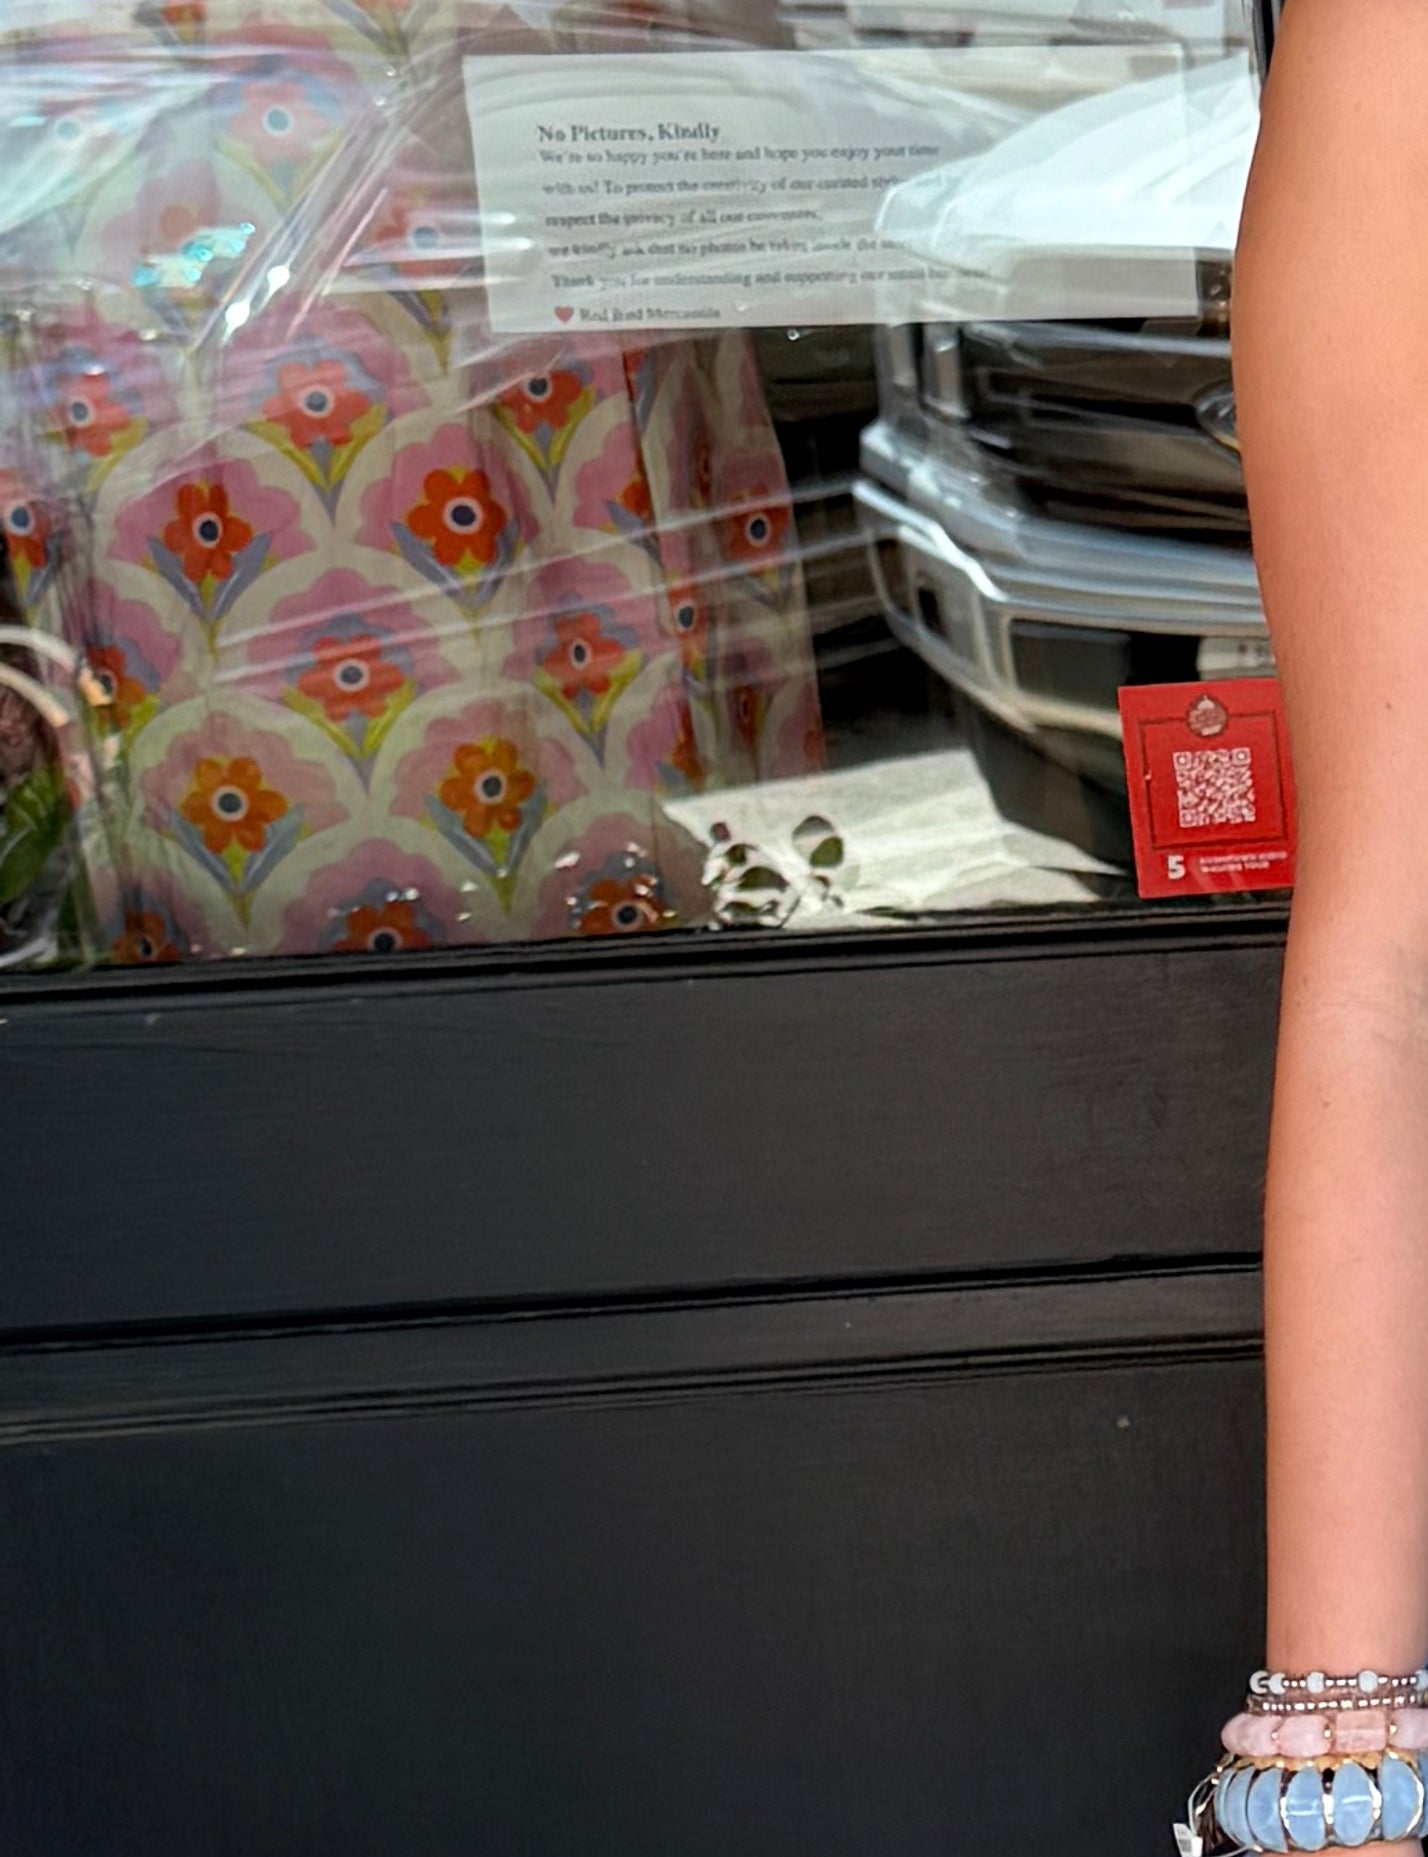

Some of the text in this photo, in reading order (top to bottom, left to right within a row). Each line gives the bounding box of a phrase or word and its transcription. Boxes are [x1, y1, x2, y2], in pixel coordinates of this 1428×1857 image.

[538, 122, 721, 143] No Pictures, Kindly
[606, 149, 648, 165] happy
[702, 147, 732, 161] here
[736, 146, 760, 161] and
[764, 146, 798, 162] hope
[802, 148, 829, 162] you
[831, 146, 870, 161] enjoy
[873, 146, 906, 161] your
[543, 182, 575, 194] with
[604, 180, 624, 193] To
[678, 180, 698, 192] the
[771, 177, 788, 190] of
[546, 214, 596, 228] respect
[598, 212, 620, 225] the
[756, 270, 781, 283] and
[1167, 854, 1187, 881] 5
